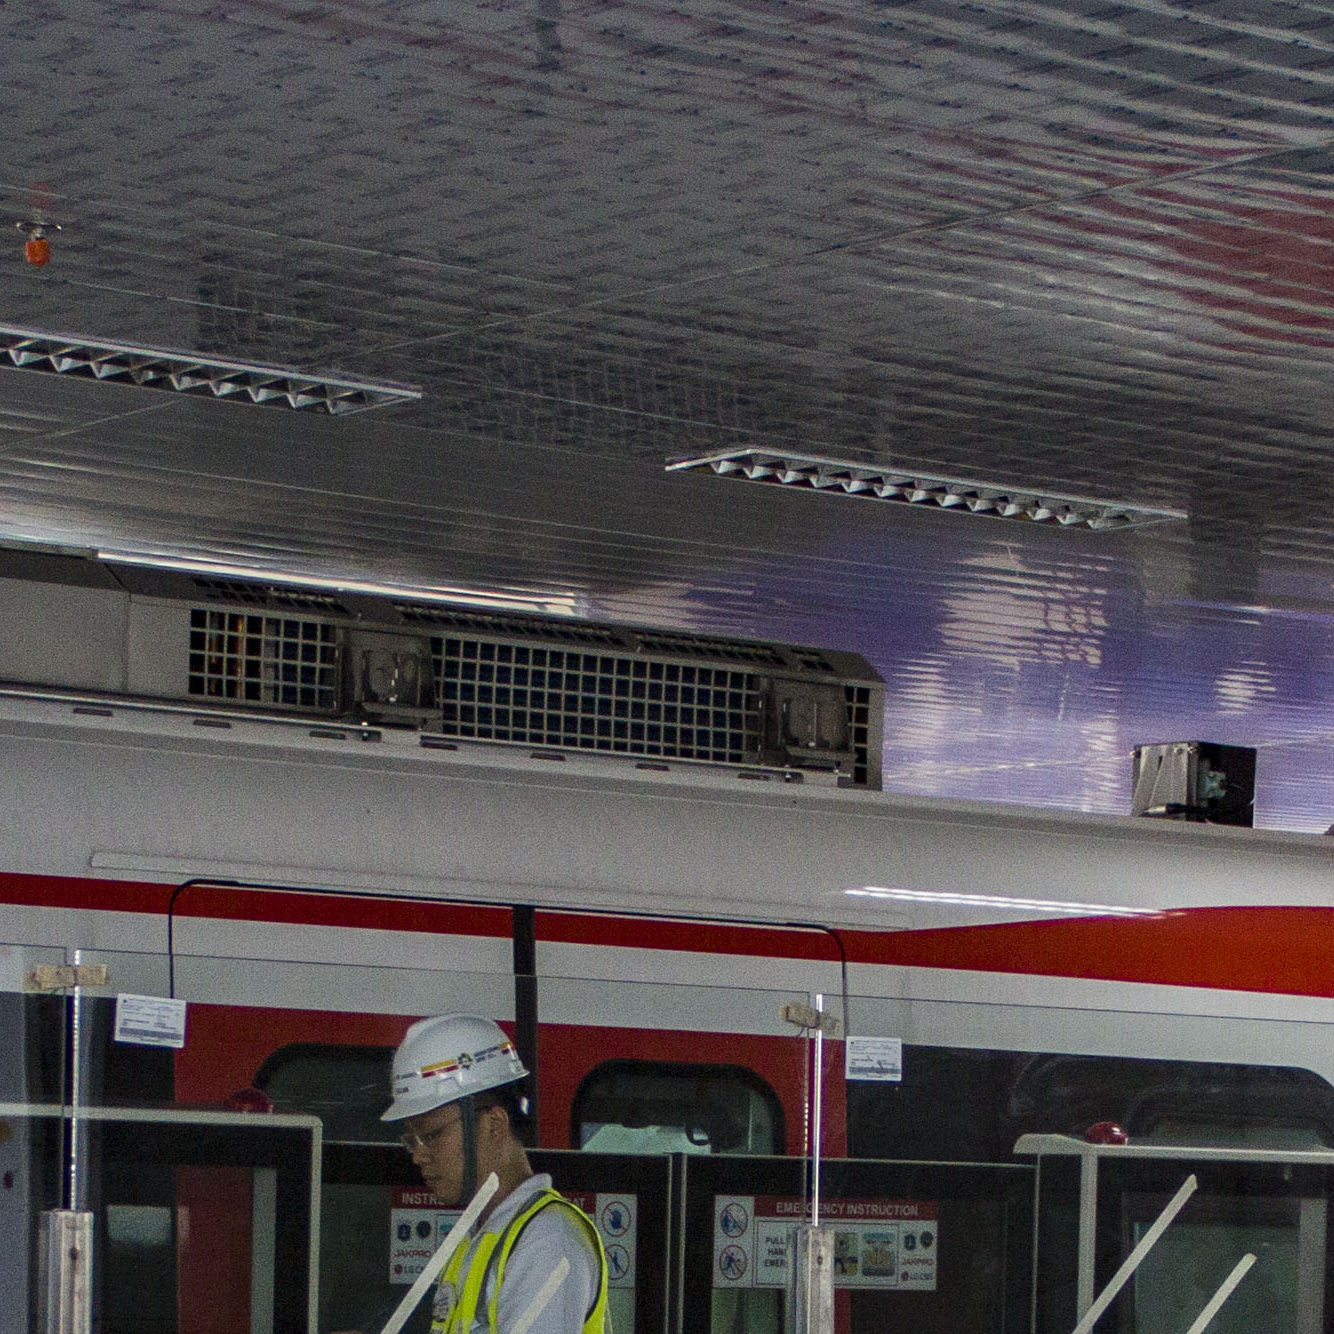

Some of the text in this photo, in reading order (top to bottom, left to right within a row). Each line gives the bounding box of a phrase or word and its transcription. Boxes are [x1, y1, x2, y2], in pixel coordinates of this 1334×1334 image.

[776, 1203, 919, 1215] EMEGENCY INSTRUCTION
[765, 1237, 785, 1245] PULL
[394, 1250, 431, 1258] JAKPRO
